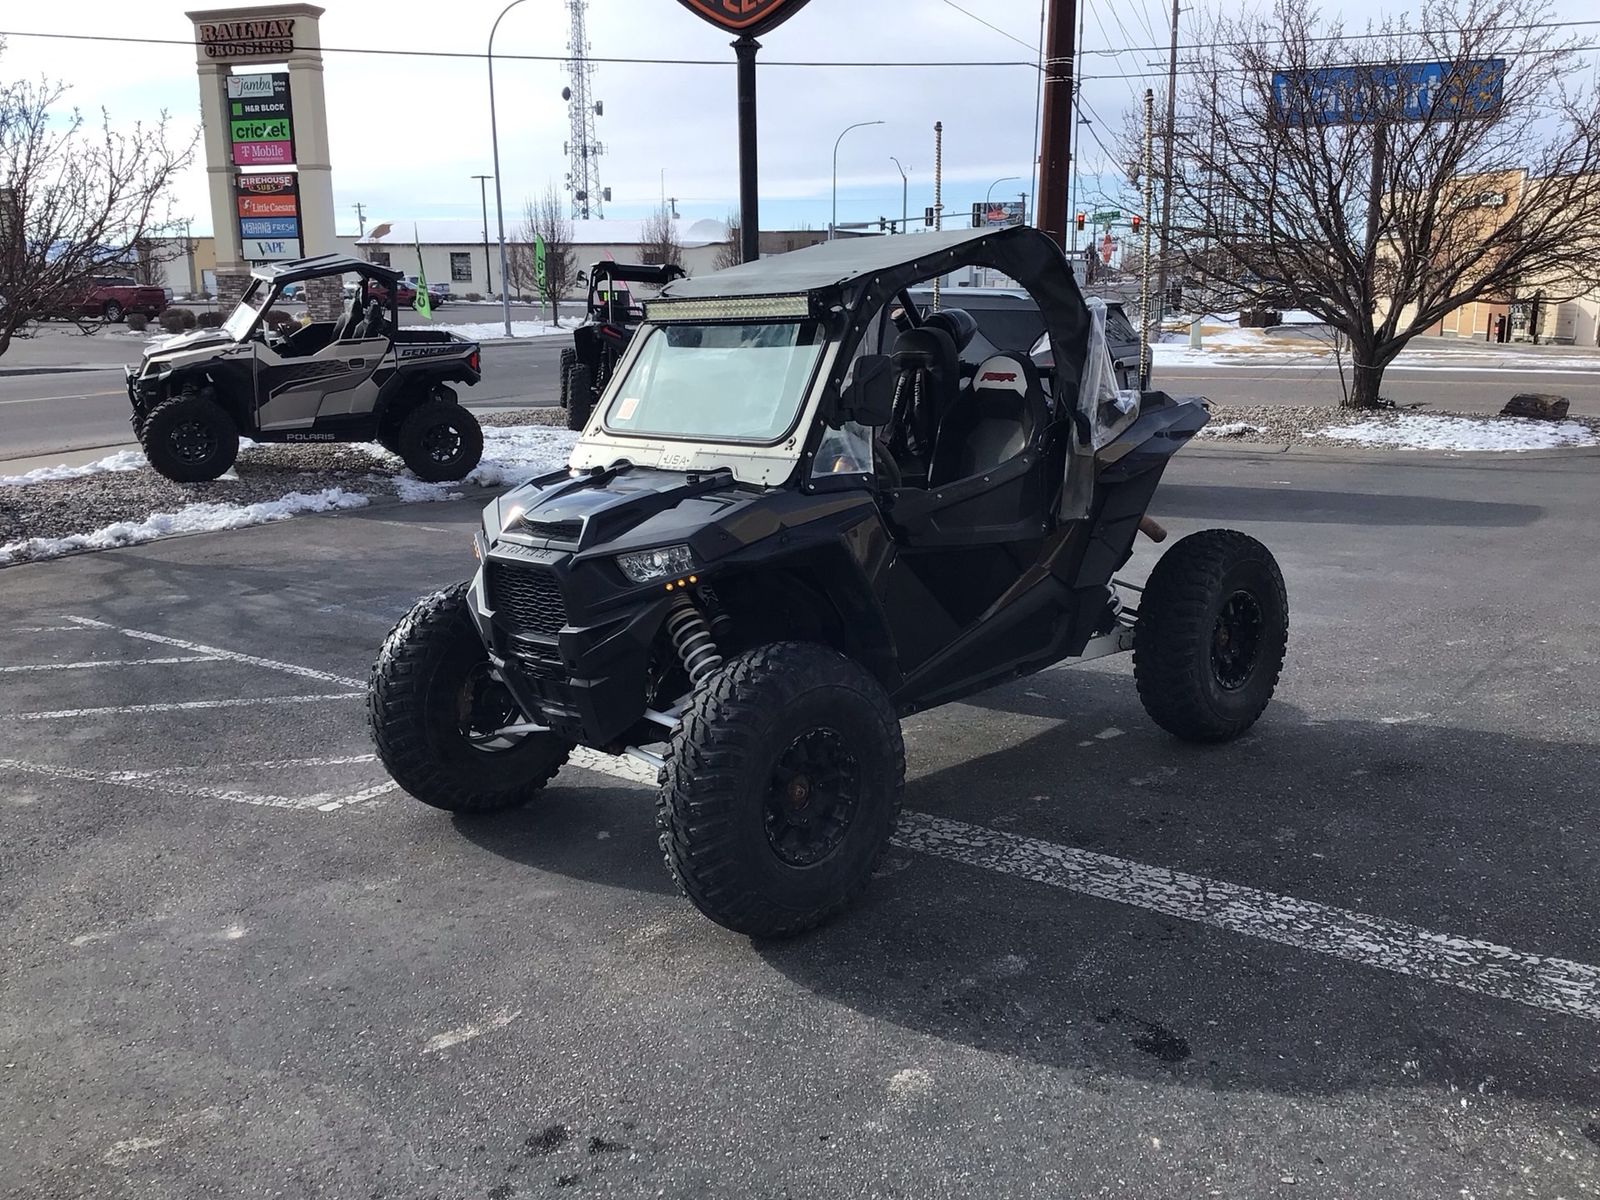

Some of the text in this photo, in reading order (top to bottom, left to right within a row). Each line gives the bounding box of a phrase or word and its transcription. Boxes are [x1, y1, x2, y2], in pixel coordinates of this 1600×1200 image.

[200, 19, 295, 41] RAILWAY
[205, 39, 293, 57] CROSSINGS
[238, 76, 272, 96] jamba
[244, 103, 285, 113] H&R BLOCK
[236, 122, 286, 138] cricket
[252, 144, 284, 157] Mobile
[240, 176, 292, 188] FIREHOUSE
[256, 183, 276, 191] SUBS
[252, 202, 296, 212] Little Caesars
[257, 241, 286, 256] VAPE
[220, 346, 253, 357] XP
[402, 345, 463, 357] GENERA
[286, 432, 336, 441] POLARIS
[664, 454, 687, 465] USA
